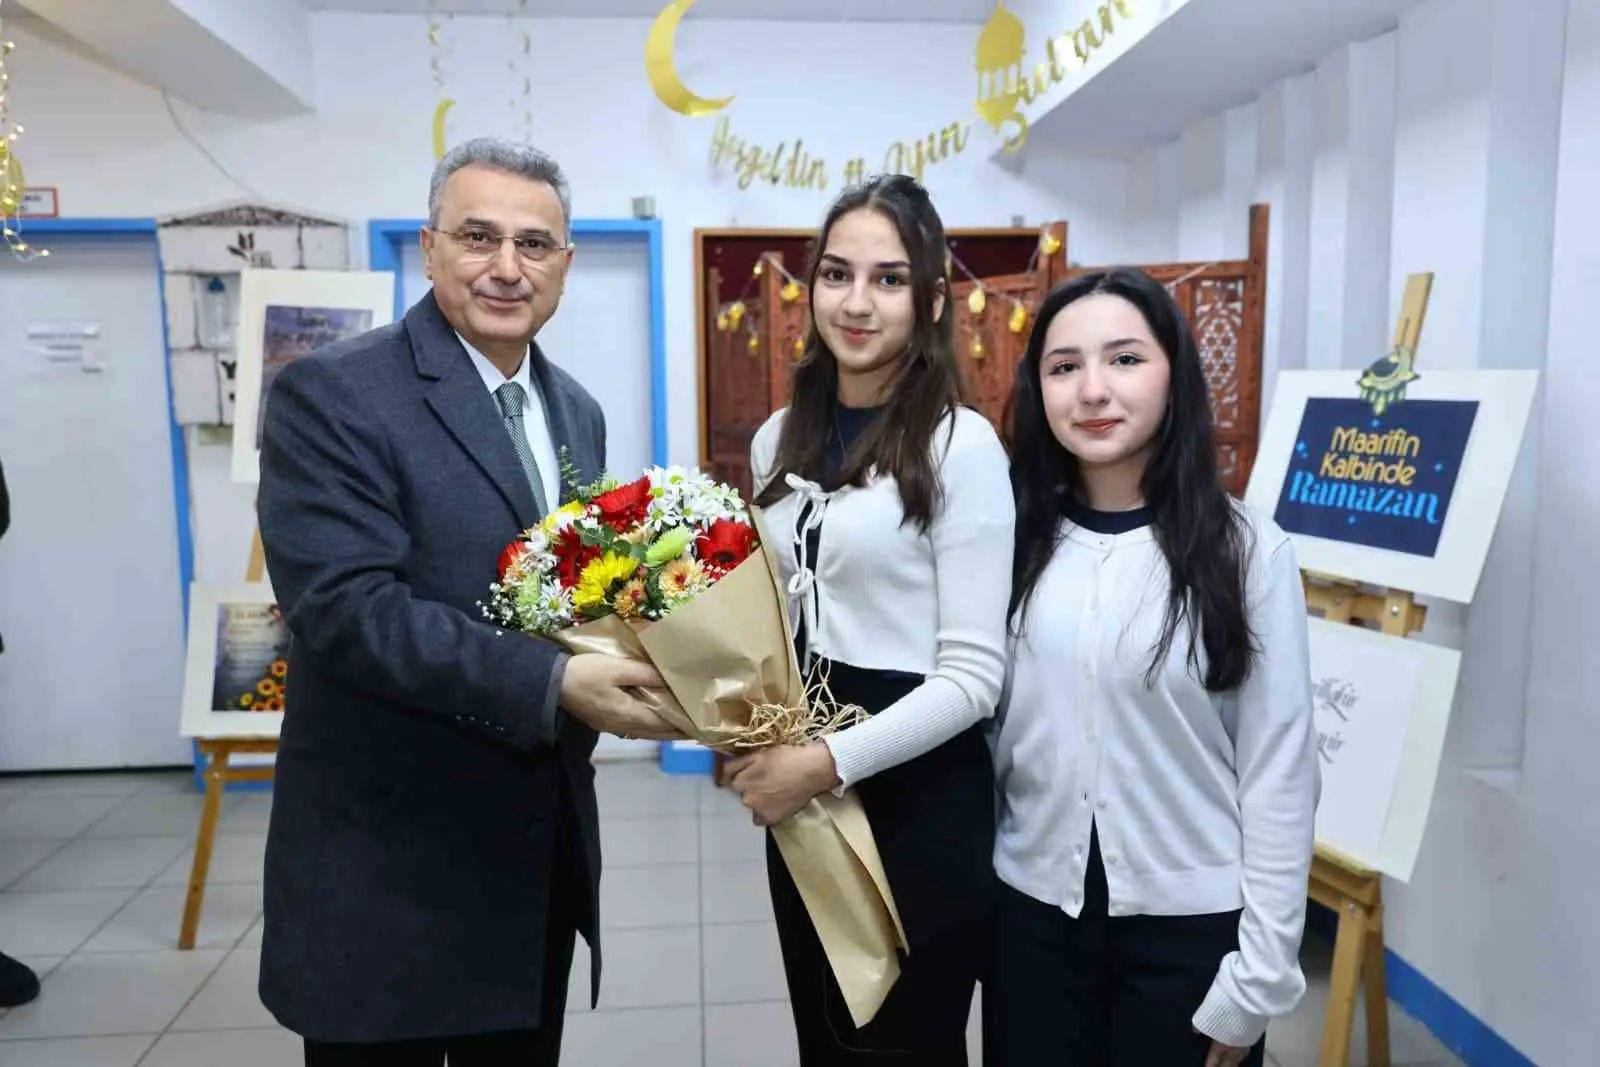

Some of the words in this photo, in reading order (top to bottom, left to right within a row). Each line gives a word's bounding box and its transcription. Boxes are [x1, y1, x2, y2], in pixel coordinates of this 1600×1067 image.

[1330, 426, 1420, 457] Maarifin
[1319, 452, 1417, 486] Kalbinde
[1288, 470, 1441, 524] Ramazan
